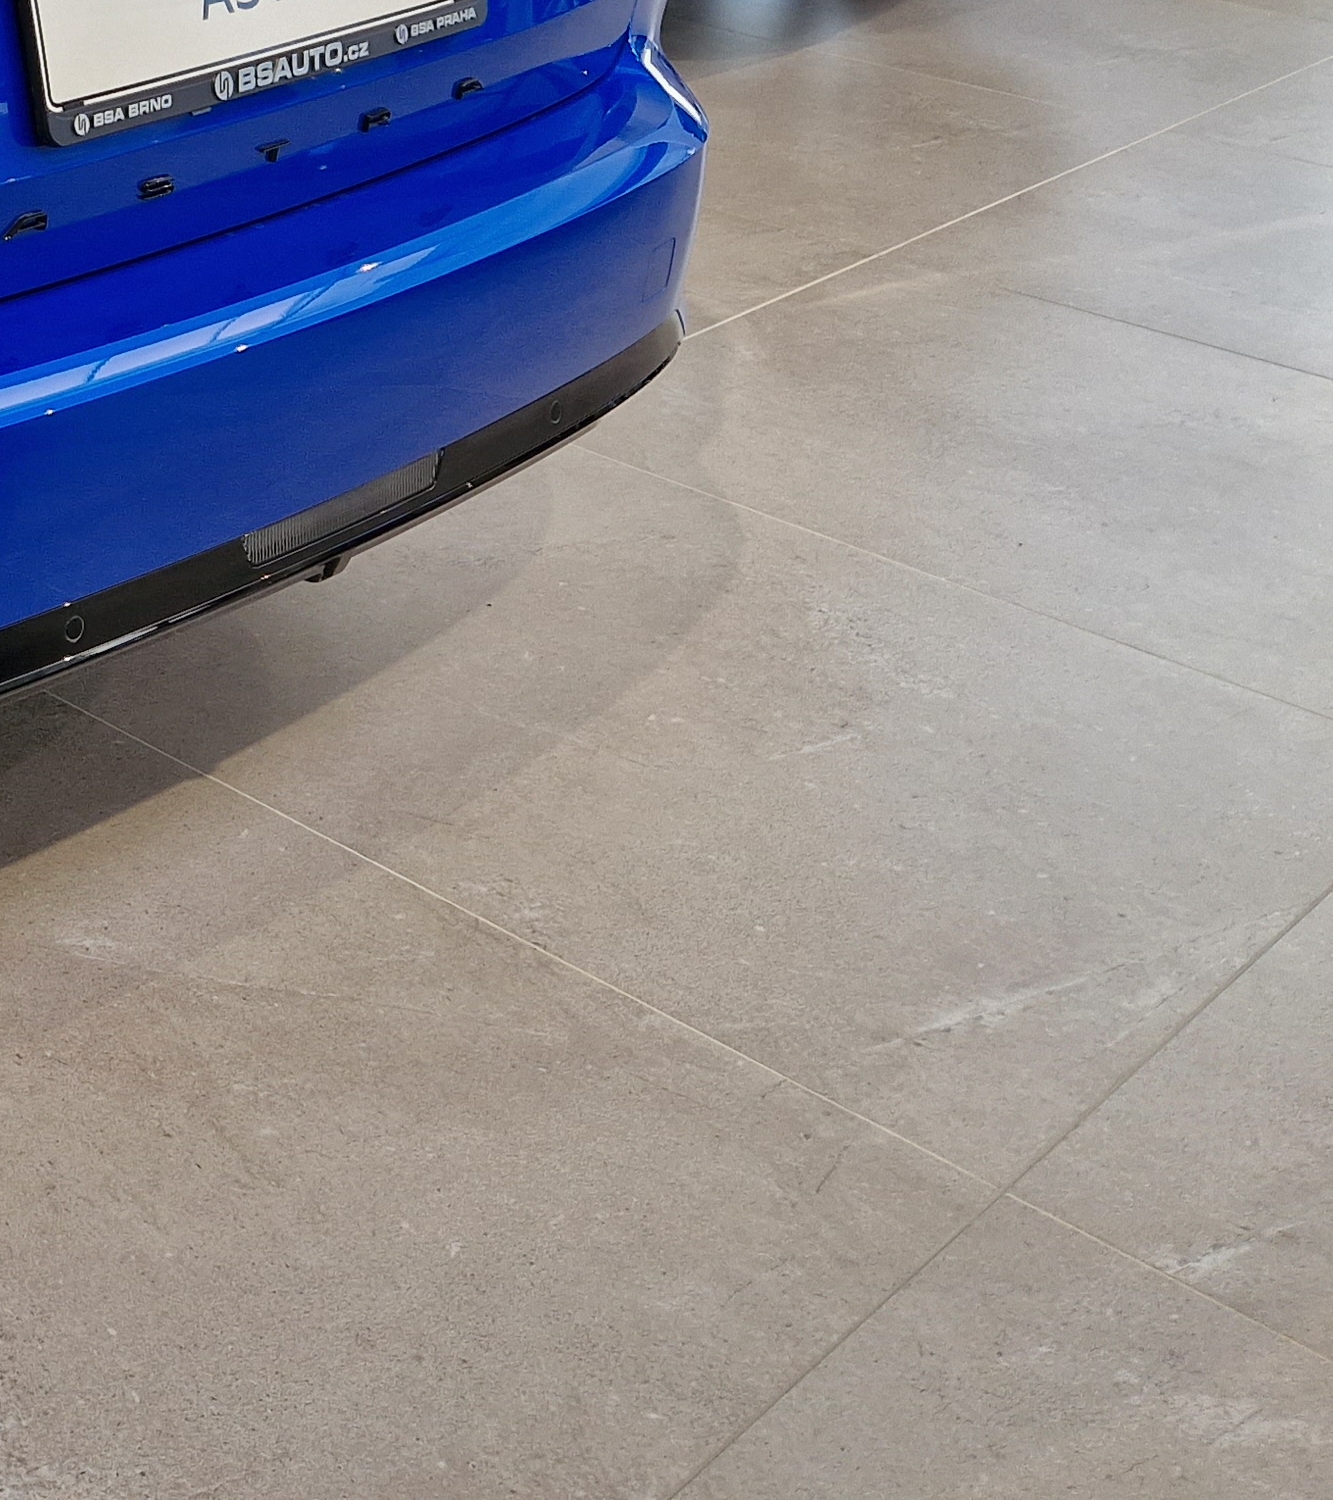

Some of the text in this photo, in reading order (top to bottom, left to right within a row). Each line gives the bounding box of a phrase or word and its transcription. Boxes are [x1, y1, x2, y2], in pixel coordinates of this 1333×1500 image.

[410, 7, 477, 37] BSA PRAHA
[238, 41, 370, 94] BSAUTO.cz
[93, 94, 173, 128] BSA BRNO
